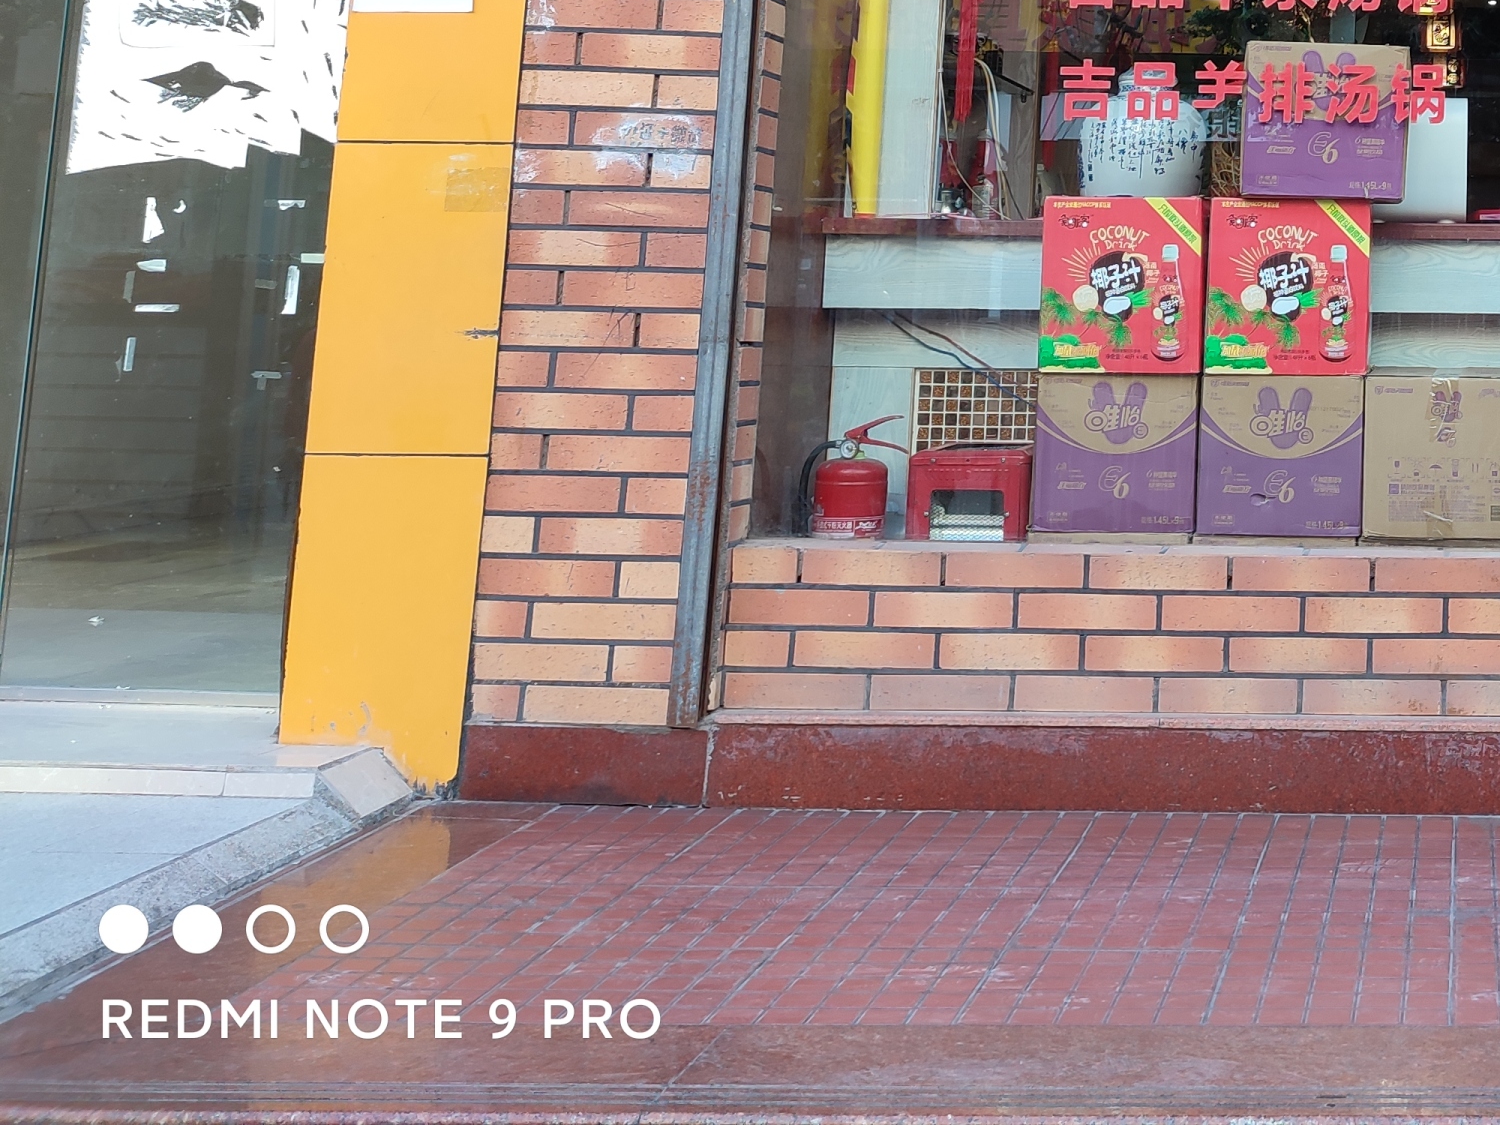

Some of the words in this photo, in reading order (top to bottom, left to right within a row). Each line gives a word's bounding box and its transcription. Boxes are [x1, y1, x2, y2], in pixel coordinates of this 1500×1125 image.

[1089, 224, 1151, 247] COCONUT
[1104, 238, 1138, 251] Drink
[1258, 225, 1319, 247] COCONUT
[1271, 239, 1306, 251] Drink
[1090, 258, 1142, 290] 椰子汁
[1258, 259, 1309, 290] 椰子汁
